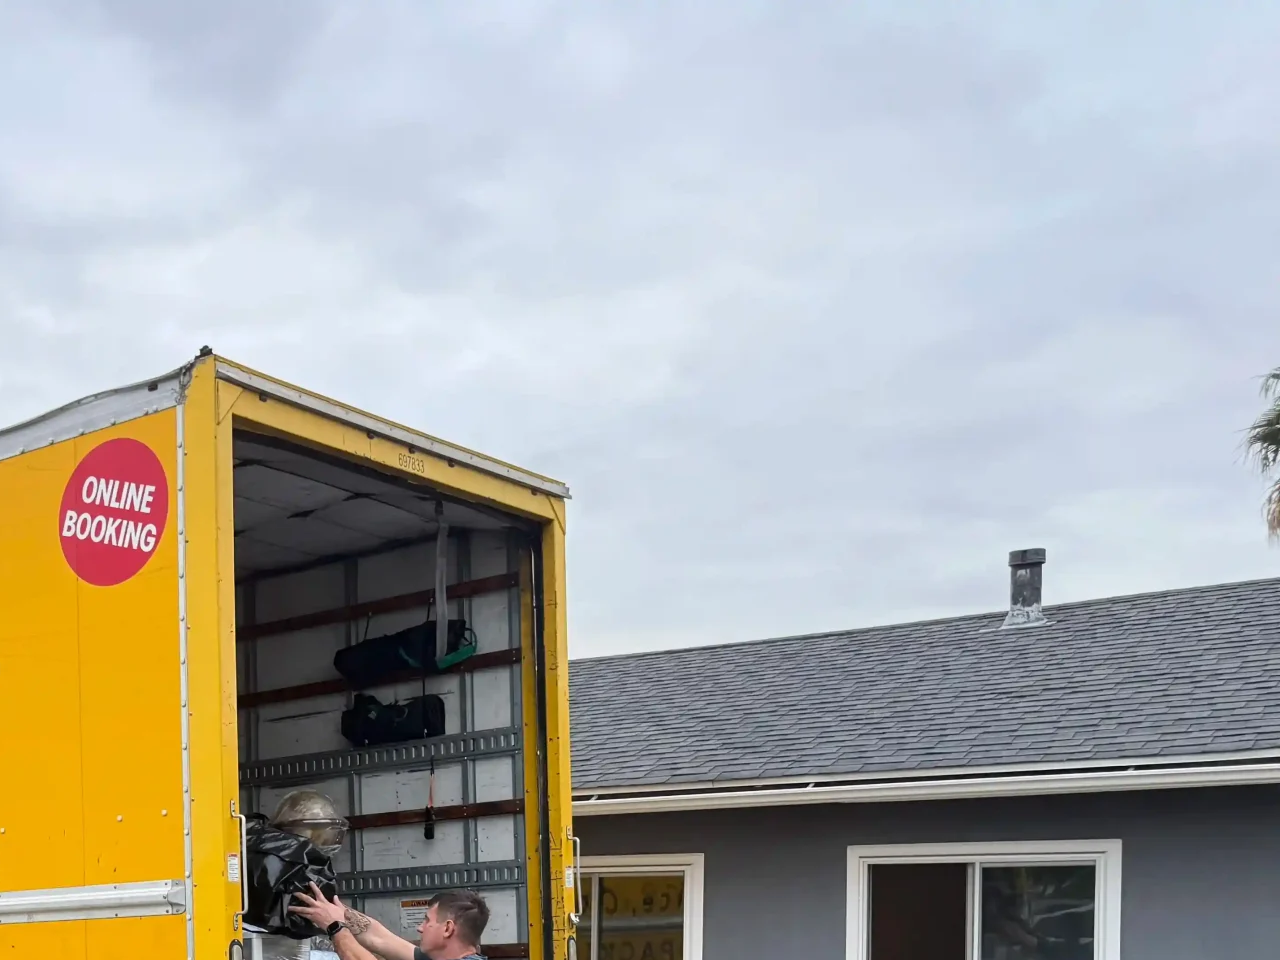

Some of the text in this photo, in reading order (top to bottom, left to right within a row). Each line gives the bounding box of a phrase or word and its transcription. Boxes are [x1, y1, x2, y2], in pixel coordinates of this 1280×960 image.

[398, 452, 425, 474] 697833
[81, 475, 156, 514] ONLINE
[61, 509, 157, 553] BOOKING
